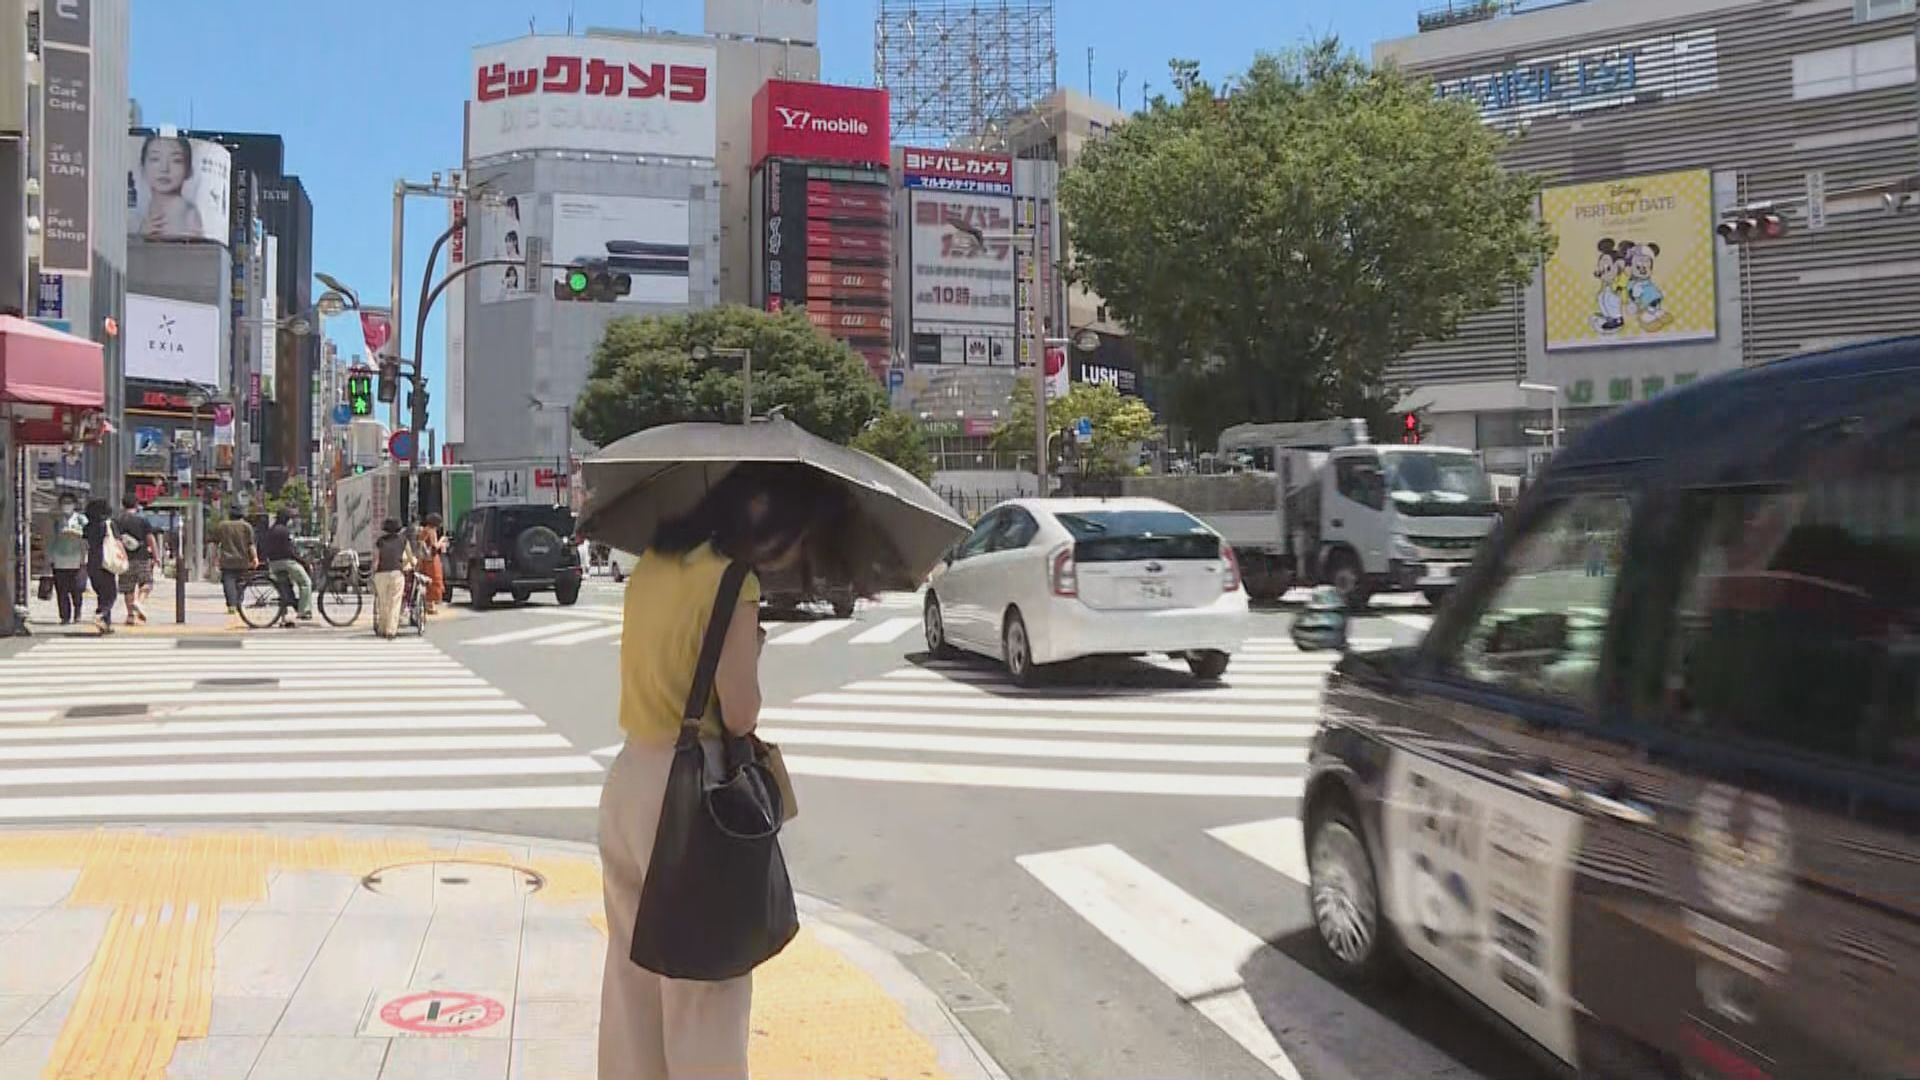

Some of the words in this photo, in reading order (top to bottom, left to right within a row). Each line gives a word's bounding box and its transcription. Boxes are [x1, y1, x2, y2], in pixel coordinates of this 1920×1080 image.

[477, 56, 707, 102] ビックカメラ
[49, 84, 77, 97] Cat
[49, 98, 87, 111] Cafe
[906, 154, 1008, 176] ヨドバシカメラ
[1575, 200, 1637, 219] PERFECT
[1639, 196, 1677, 212] DATE
[47, 216, 74, 228] Pet
[47, 229, 87, 242] Shop
[149, 340, 184, 353] EXIA
[1080, 363, 1119, 388] LUSH
